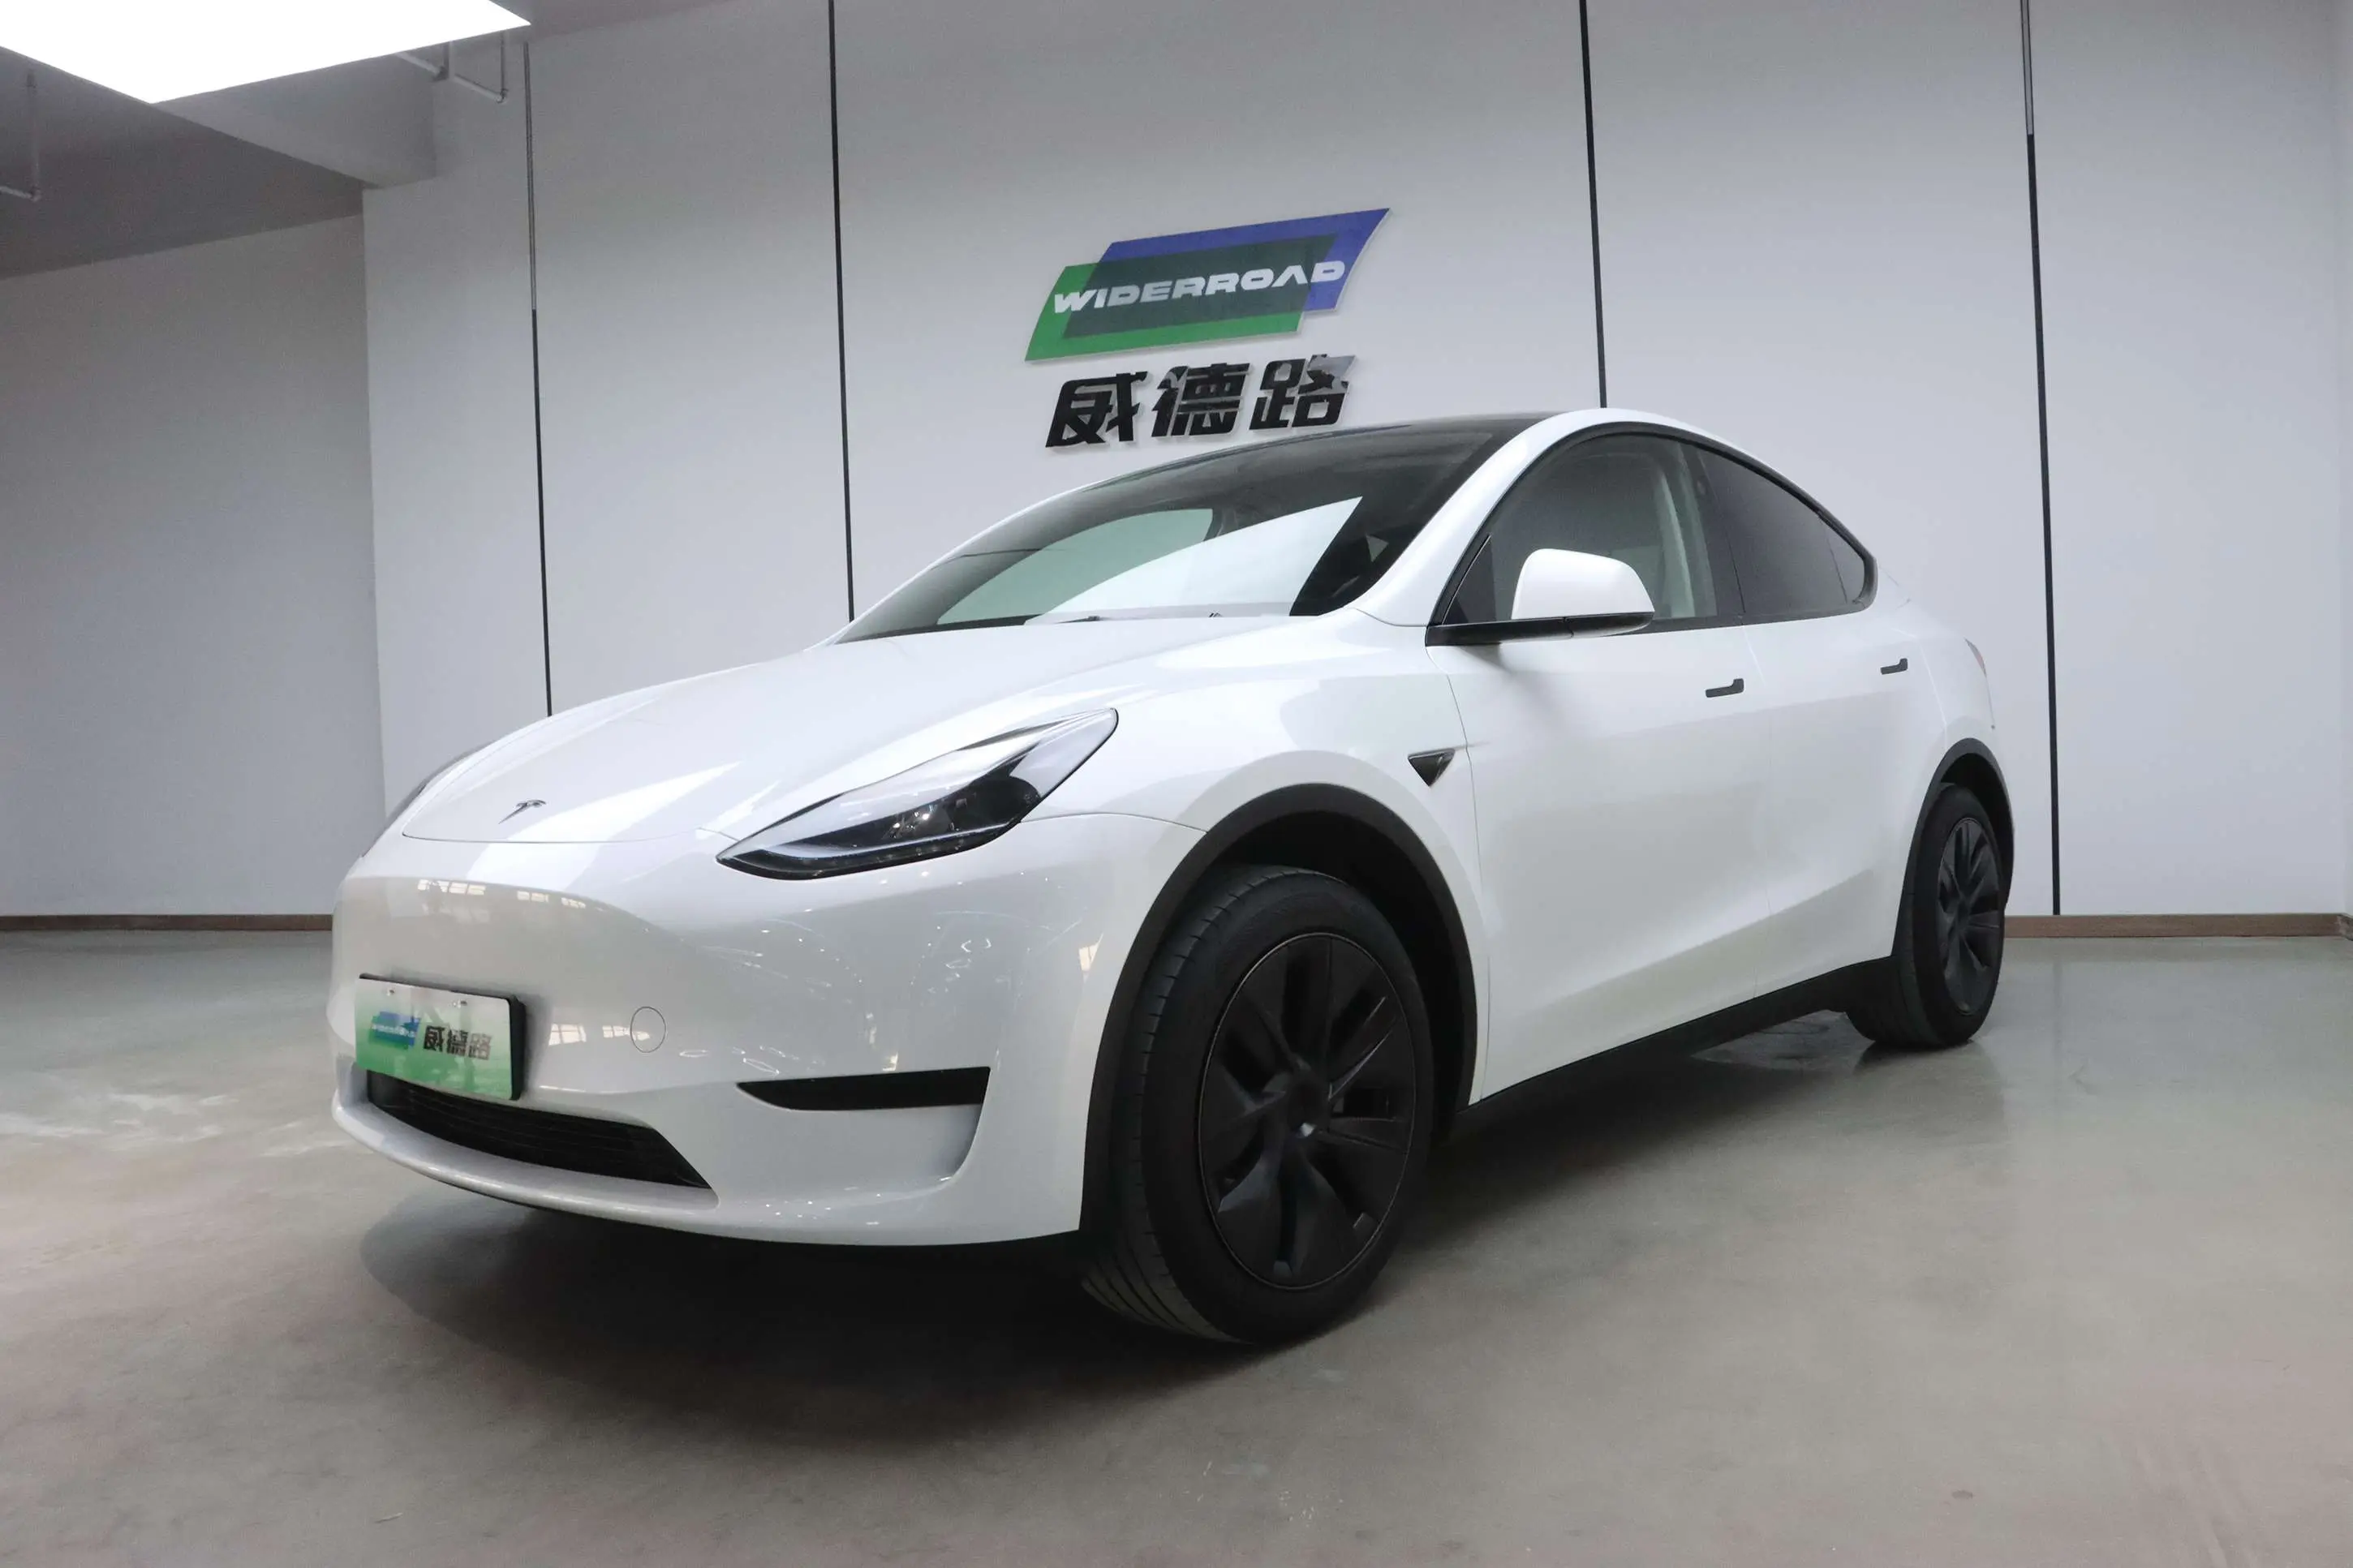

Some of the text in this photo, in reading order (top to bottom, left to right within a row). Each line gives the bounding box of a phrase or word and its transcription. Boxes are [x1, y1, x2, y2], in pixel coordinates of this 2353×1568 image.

[1055, 260, 1345, 314] WIDERROAD
[1046, 354, 1356, 448] 威德路
